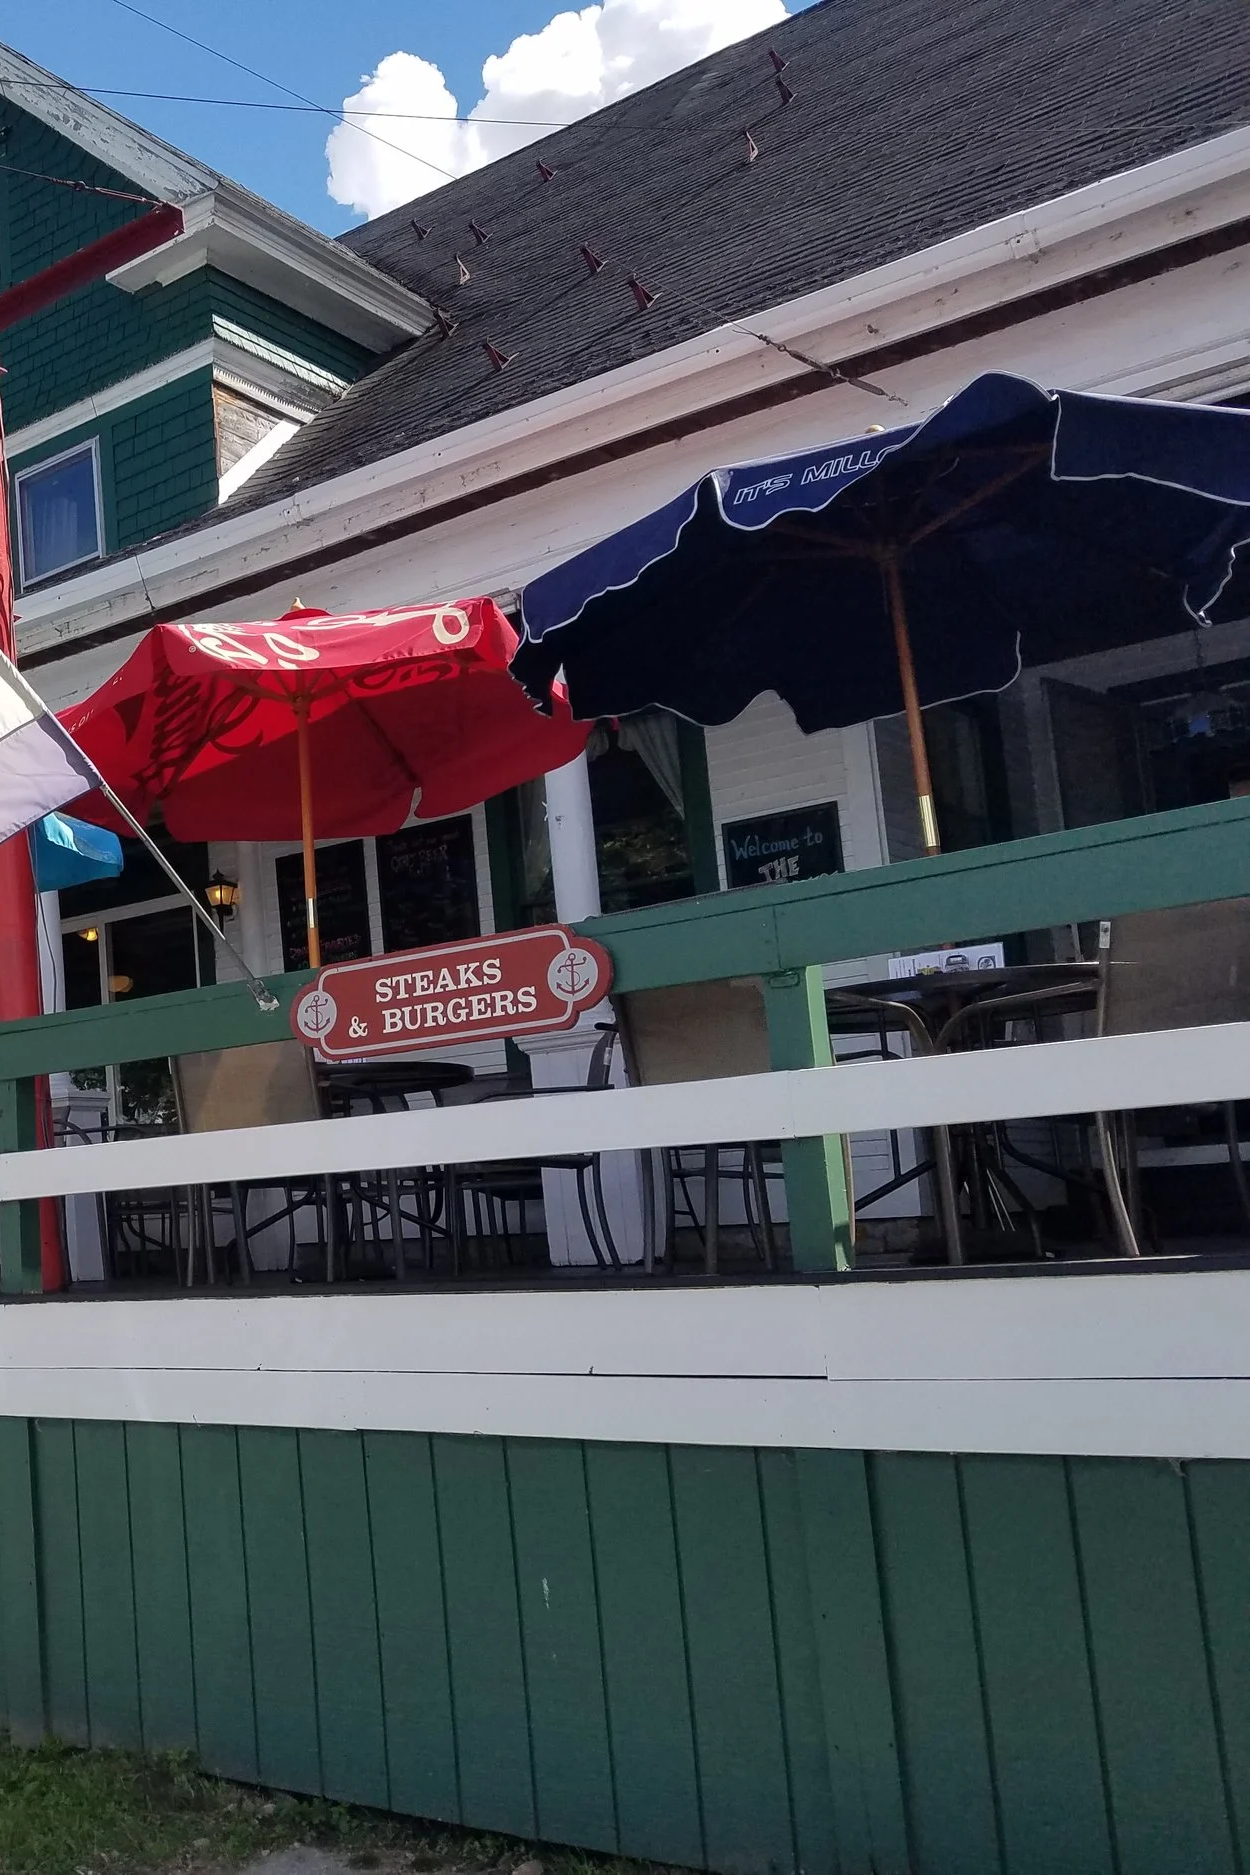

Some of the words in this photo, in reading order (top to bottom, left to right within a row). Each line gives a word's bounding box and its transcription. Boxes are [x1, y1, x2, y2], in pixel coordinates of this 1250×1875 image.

[733, 473, 793, 505] IT'S
[731, 835, 799, 861] Welcome
[803, 826, 823, 846] to
[758, 855, 800, 883] THE
[375, 958, 502, 1003] STEAKS
[349, 1016, 368, 1038] &
[382, 985, 538, 1034] BURGERS
